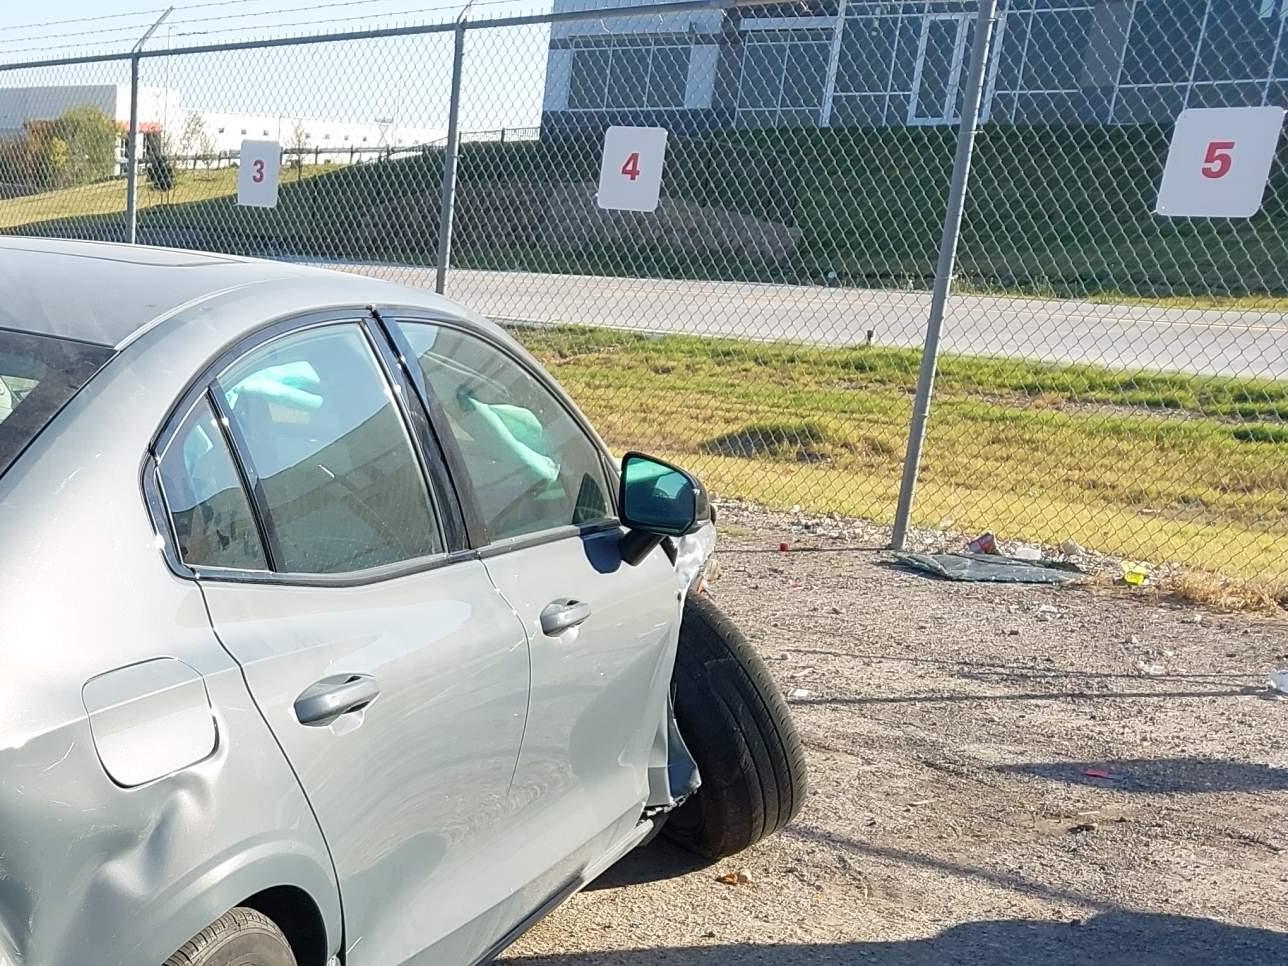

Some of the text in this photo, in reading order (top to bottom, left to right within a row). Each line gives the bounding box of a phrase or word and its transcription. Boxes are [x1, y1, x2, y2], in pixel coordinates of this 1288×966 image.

[252, 158, 266, 183] 3
[621, 152, 641, 181] 4
[1201, 141, 1236, 179] 5
